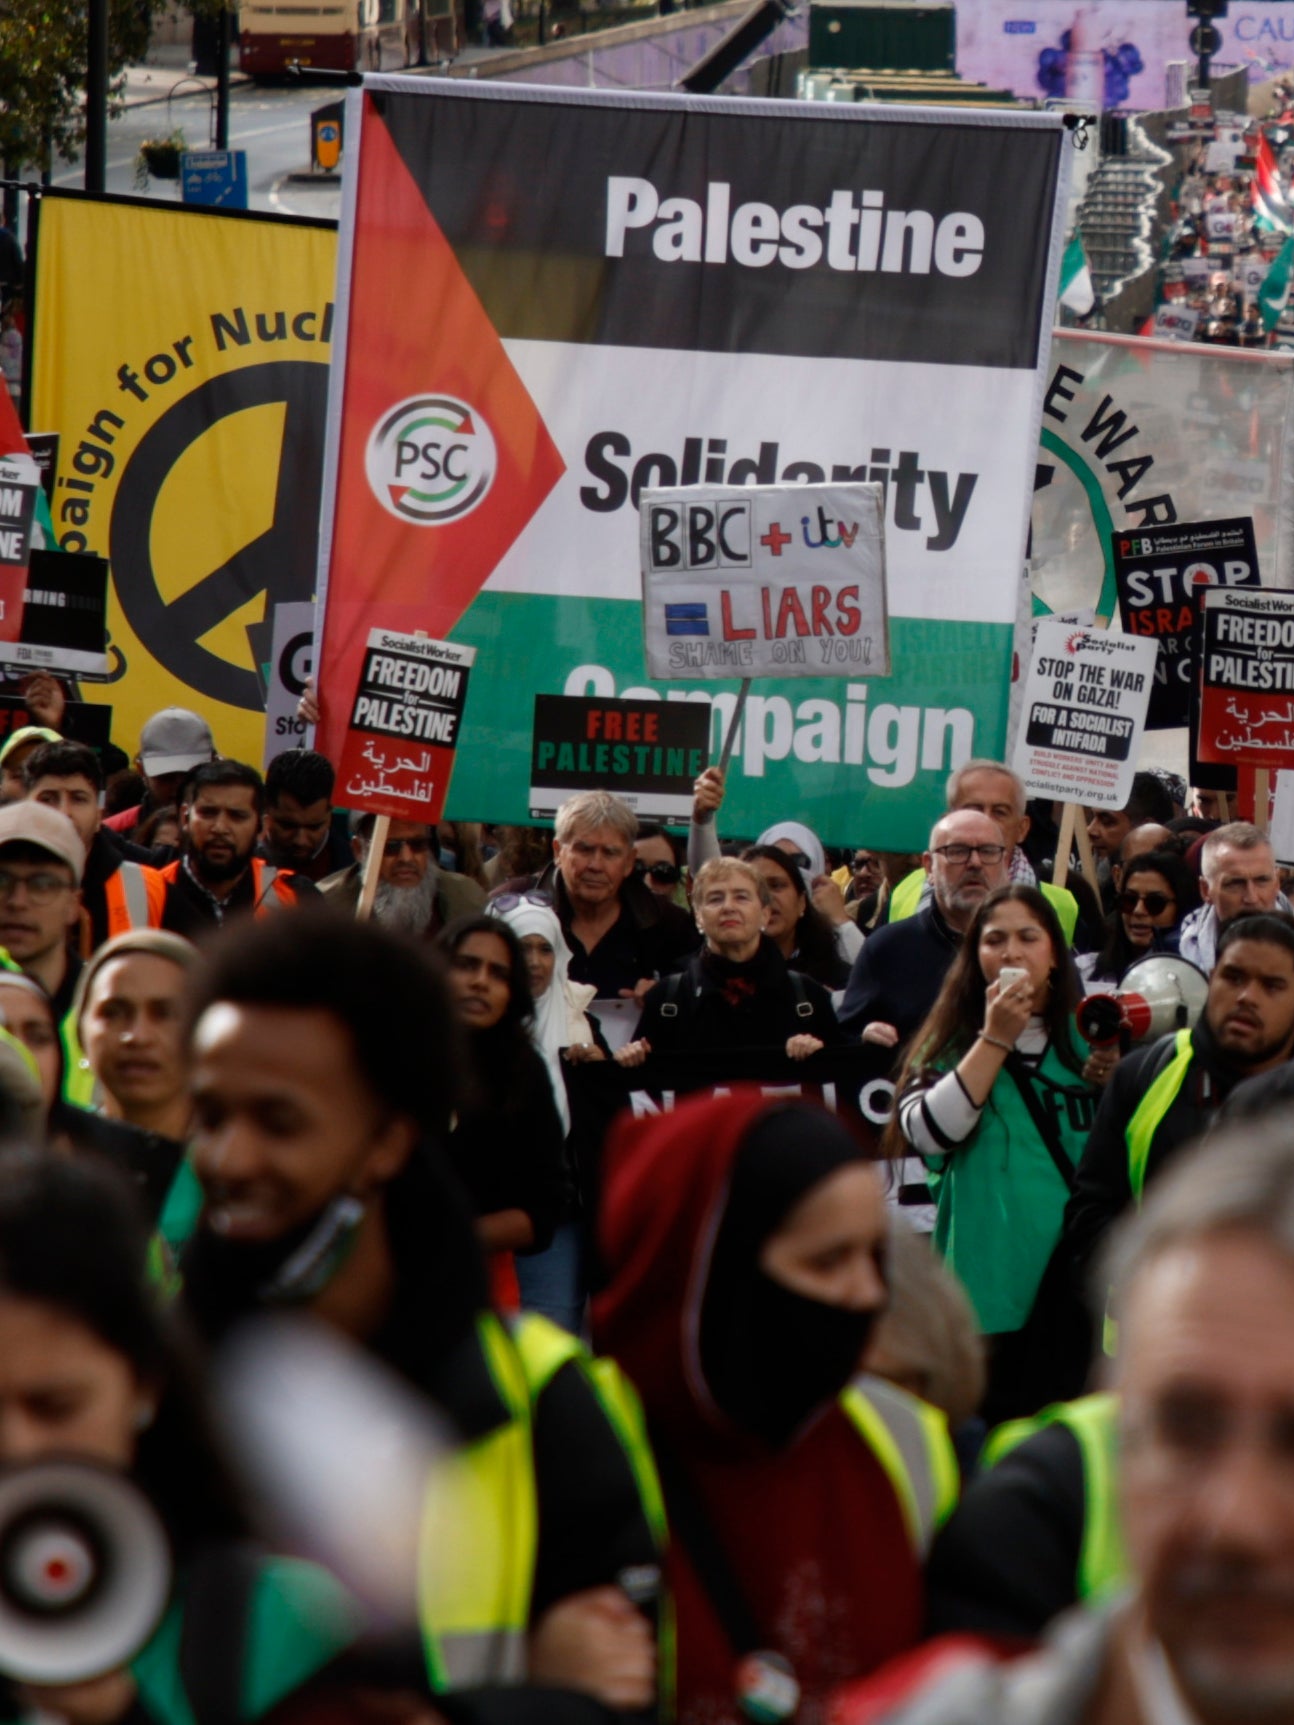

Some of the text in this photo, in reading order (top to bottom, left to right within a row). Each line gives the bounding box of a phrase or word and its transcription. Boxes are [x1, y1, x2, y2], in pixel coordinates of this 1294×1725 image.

[604, 176, 985, 278] Palestine
[116, 334, 194, 402] for
[209, 302, 334, 351] Nucl
[395, 440, 469, 482] PSC
[1080, 394, 1178, 529] WAR
[651, 507, 748, 567] BBC
[801, 506, 859, 548] itv
[1120, 538, 1153, 556] PFB
[1126, 561, 1250, 608] STOP
[721, 585, 861, 642] LIARS
[1128, 606, 1193, 635] ISRA
[669, 637, 872, 669] SHAME ON YOU!
[1082, 634, 1136, 653] Socialist
[1256, 646, 1274, 661] for
[367, 654, 461, 699] FREEDOM
[1037, 657, 1074, 680] STOP
[1078, 663, 1106, 685] THE
[1110, 668, 1145, 693] WAR
[402, 691, 420, 706] for
[1053, 681, 1121, 710] ON GAZA!
[353, 696, 457, 743] PALESTINE
[586, 710, 660, 742] FREE
[1032, 705, 1133, 739] FOR A SOCIALIST
[361, 740, 431, 773] الحرية
[1051, 729, 1107, 753] INTIFADA
[537, 741, 705, 777] PALESTINE
[346, 772, 434, 803] لفلسطين
[1024, 780, 1118, 802] ocialistparty.org.uk
